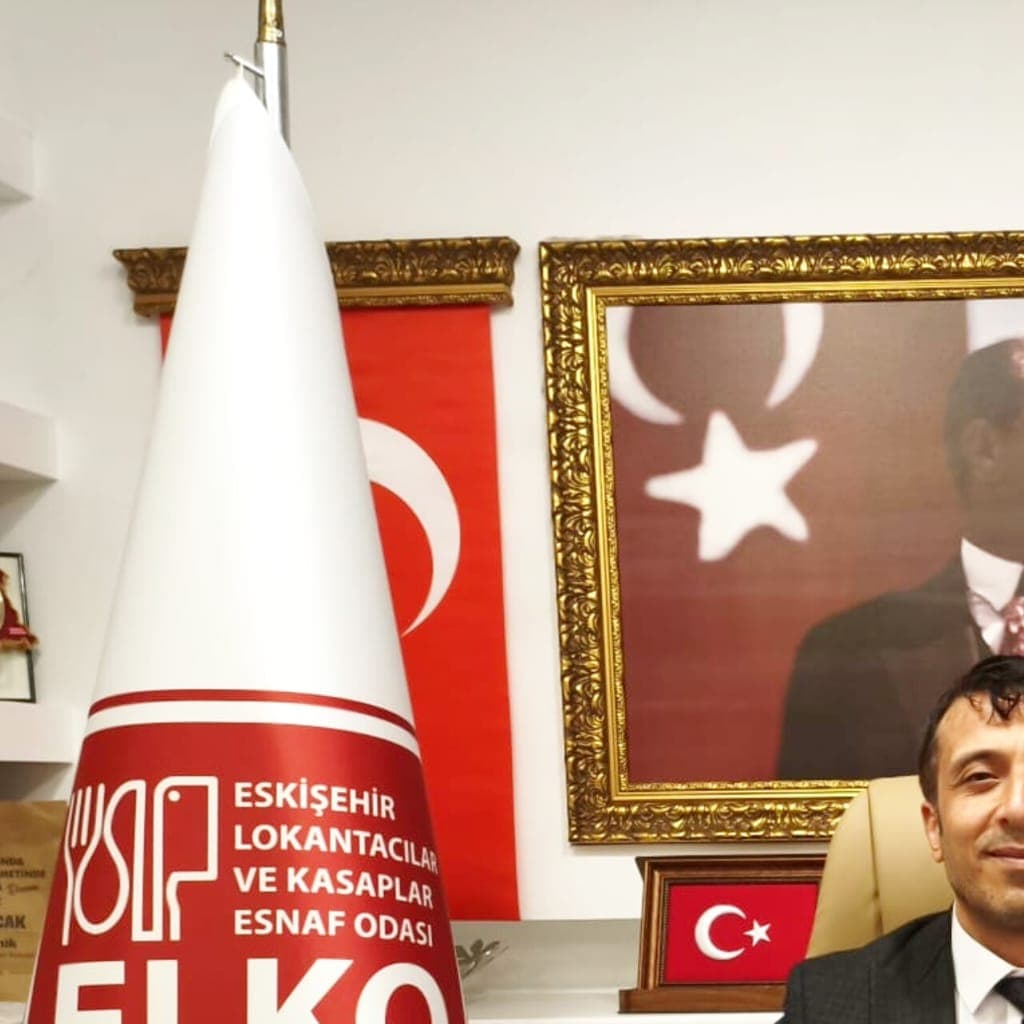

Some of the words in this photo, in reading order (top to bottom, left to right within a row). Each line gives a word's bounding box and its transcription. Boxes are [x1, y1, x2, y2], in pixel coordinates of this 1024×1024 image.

[234, 776, 395, 821] ESKİŞEHİR
[234, 823, 438, 873] LOKANTACILAR
[233, 866, 278, 893] VE
[287, 866, 434, 908] KASAPLAR
[234, 908, 347, 937] ESNAF
[353, 912, 433, 947] ODASI
